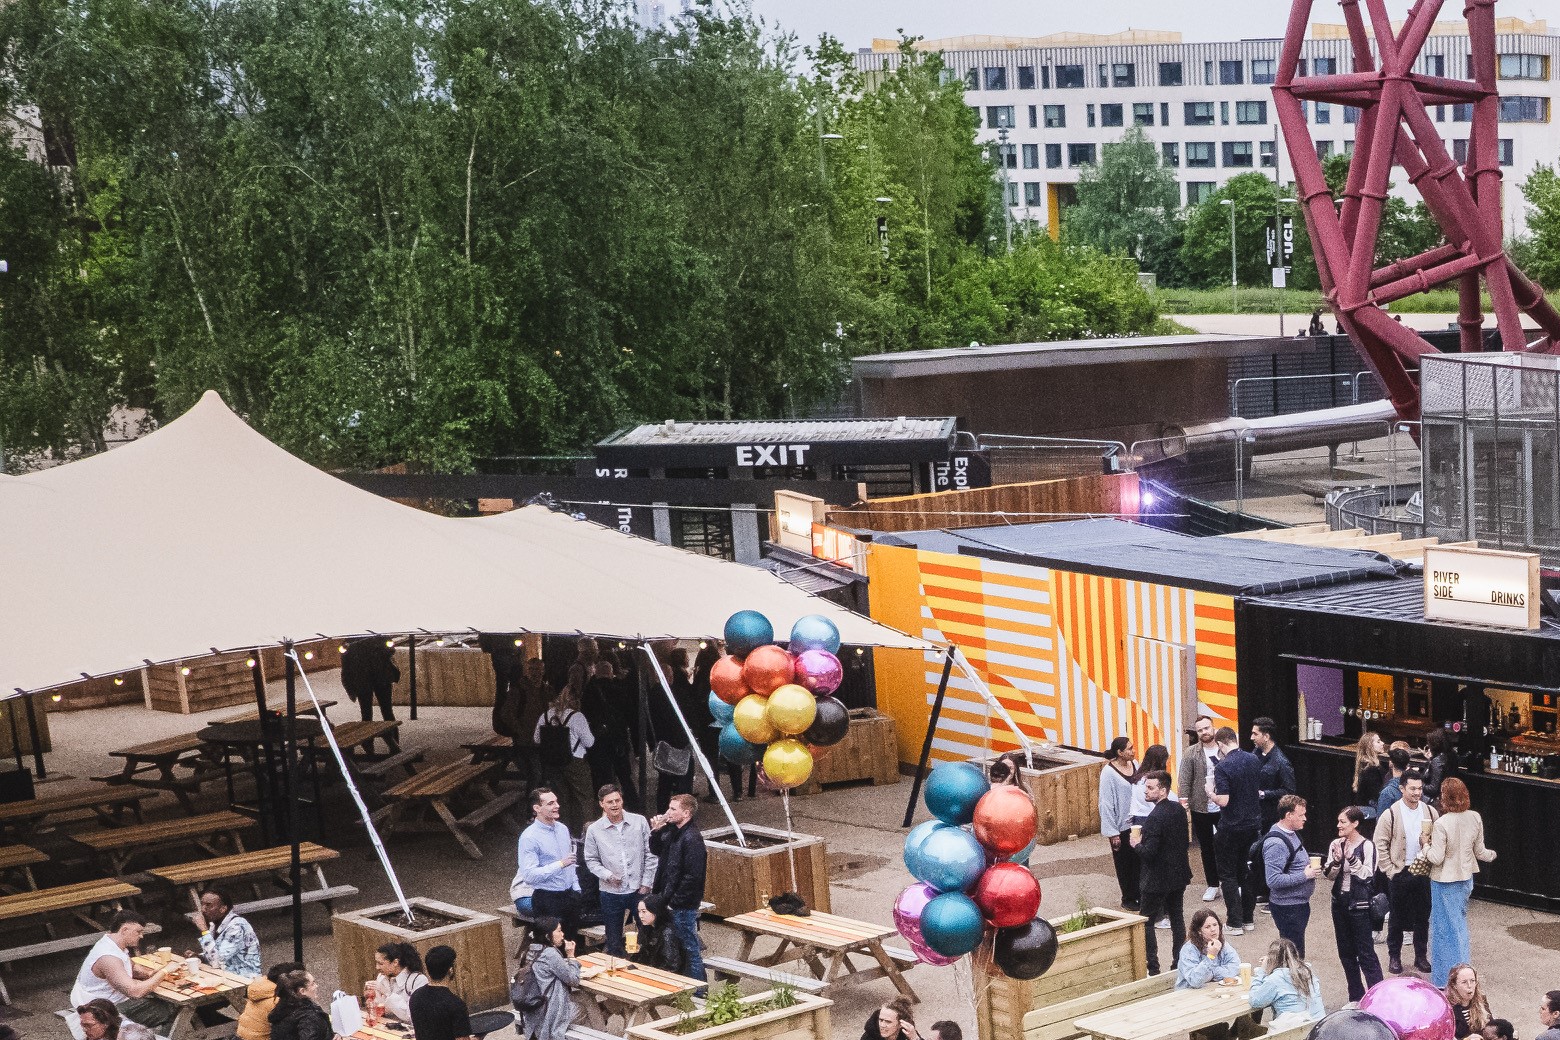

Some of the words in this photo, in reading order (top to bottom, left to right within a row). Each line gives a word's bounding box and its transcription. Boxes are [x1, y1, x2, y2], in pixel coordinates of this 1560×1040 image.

[1283, 218, 1294, 254] UCL
[736, 444, 810, 466] EXIT
[1433, 570, 1460, 584] RIVER
[1433, 584, 1454, 598] SIDE
[1491, 590, 1525, 605] DRINKS
